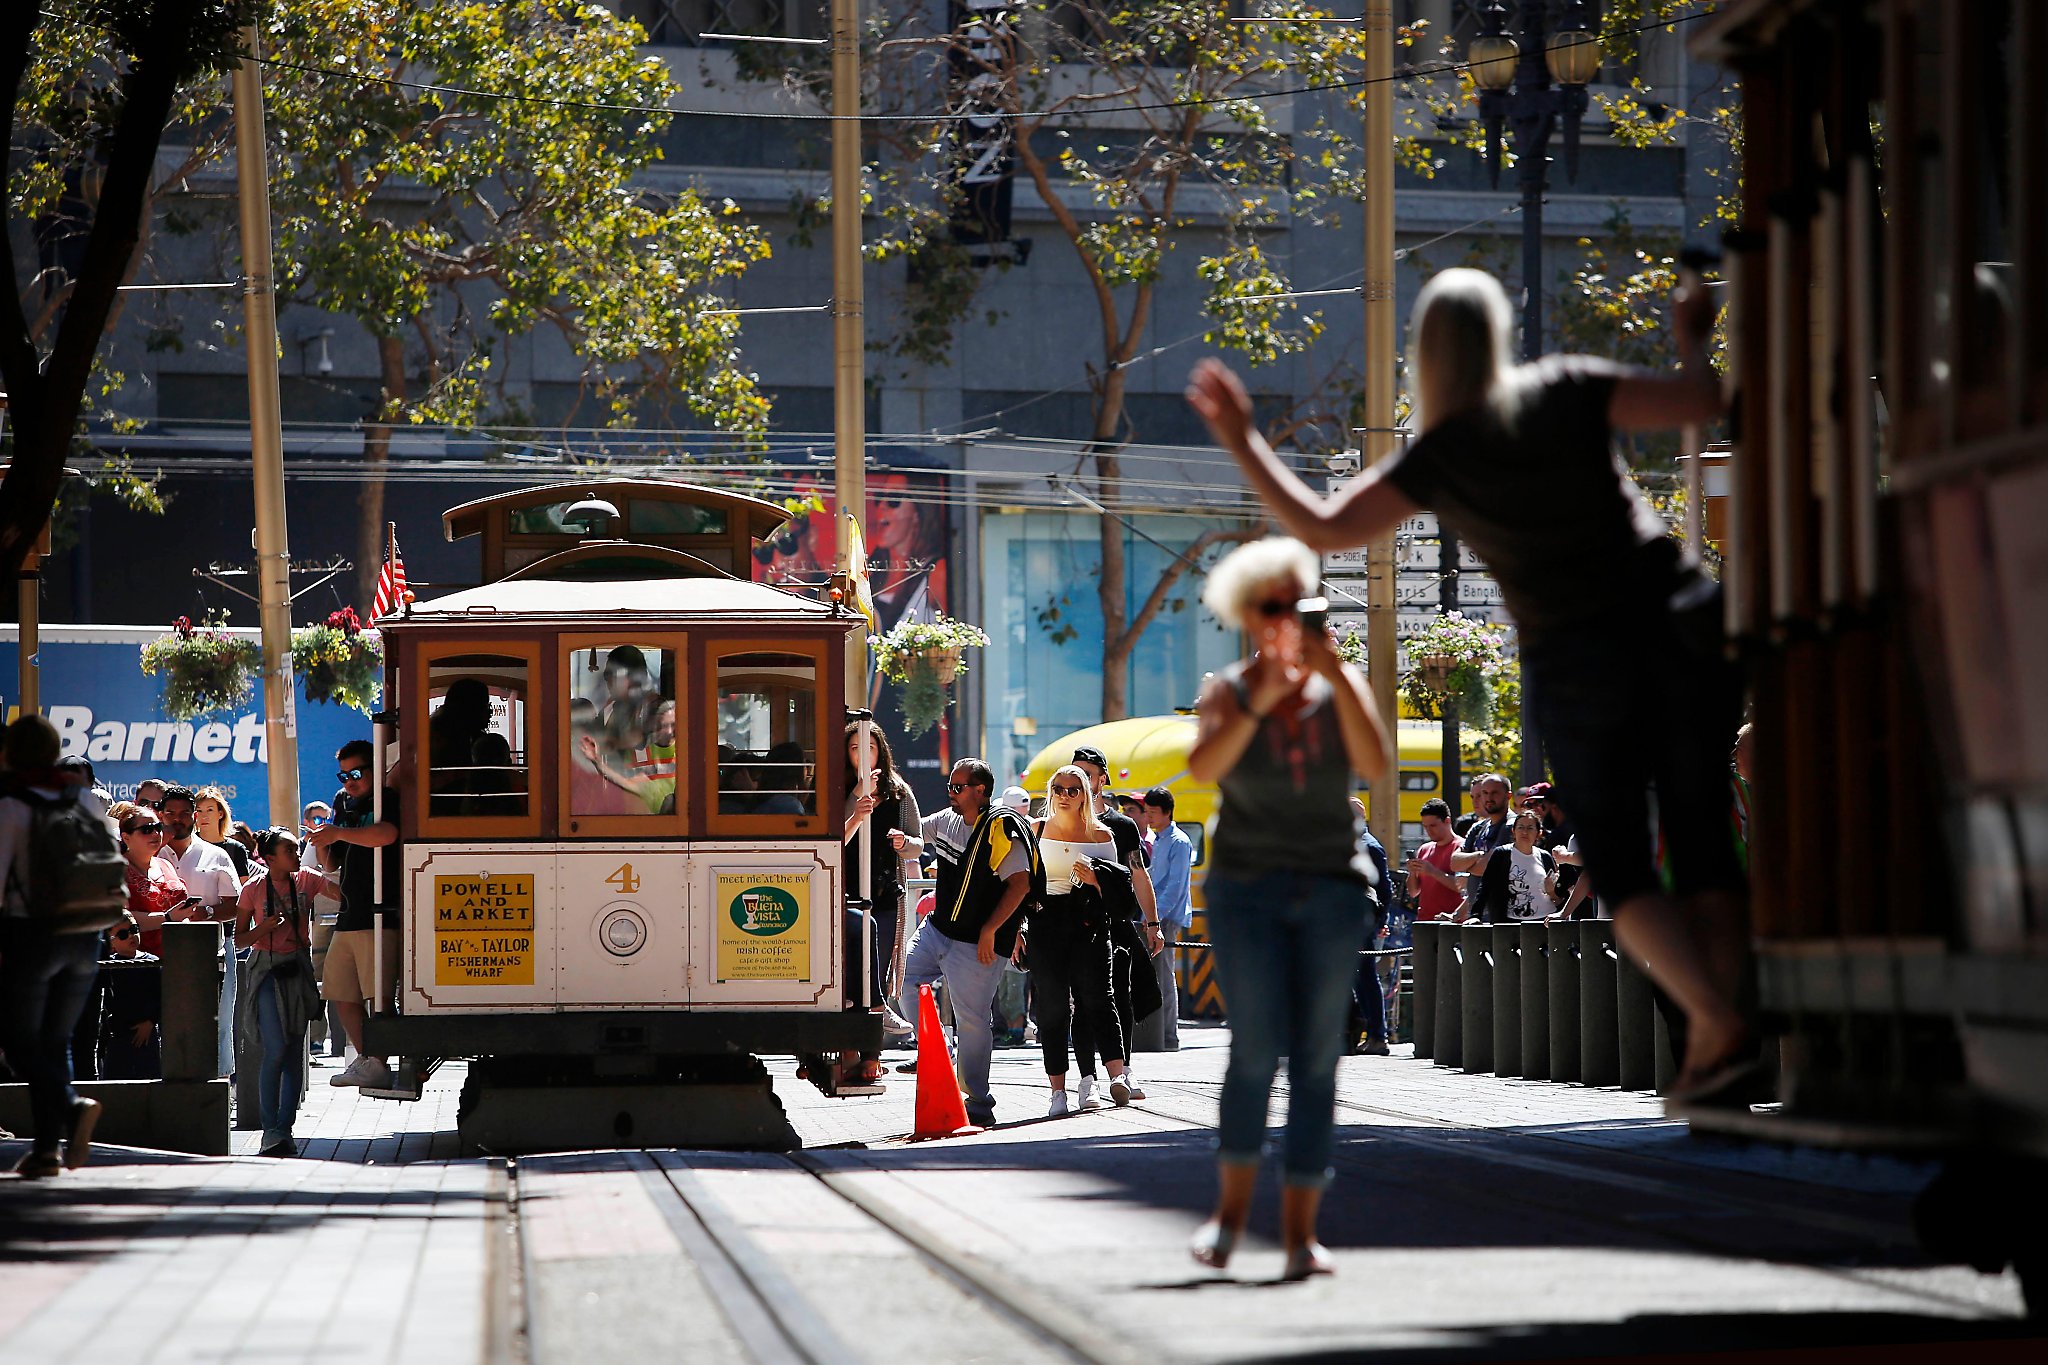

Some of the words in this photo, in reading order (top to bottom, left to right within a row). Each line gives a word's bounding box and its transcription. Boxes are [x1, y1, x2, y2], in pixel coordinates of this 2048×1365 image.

[1396, 518, 1424, 531] aifa
[1396, 584, 1426, 598] aris
[604, 862, 641, 894] 4
[441, 883, 528, 896] POWELL
[464, 897, 507, 907] AND
[439, 908, 529, 920] MARKET
[440, 939, 463, 953] BAY
[481, 938, 529, 952] TAYLOR
[448, 956, 521, 967] FISHERMANS
[465, 968, 504, 978] WHARF
